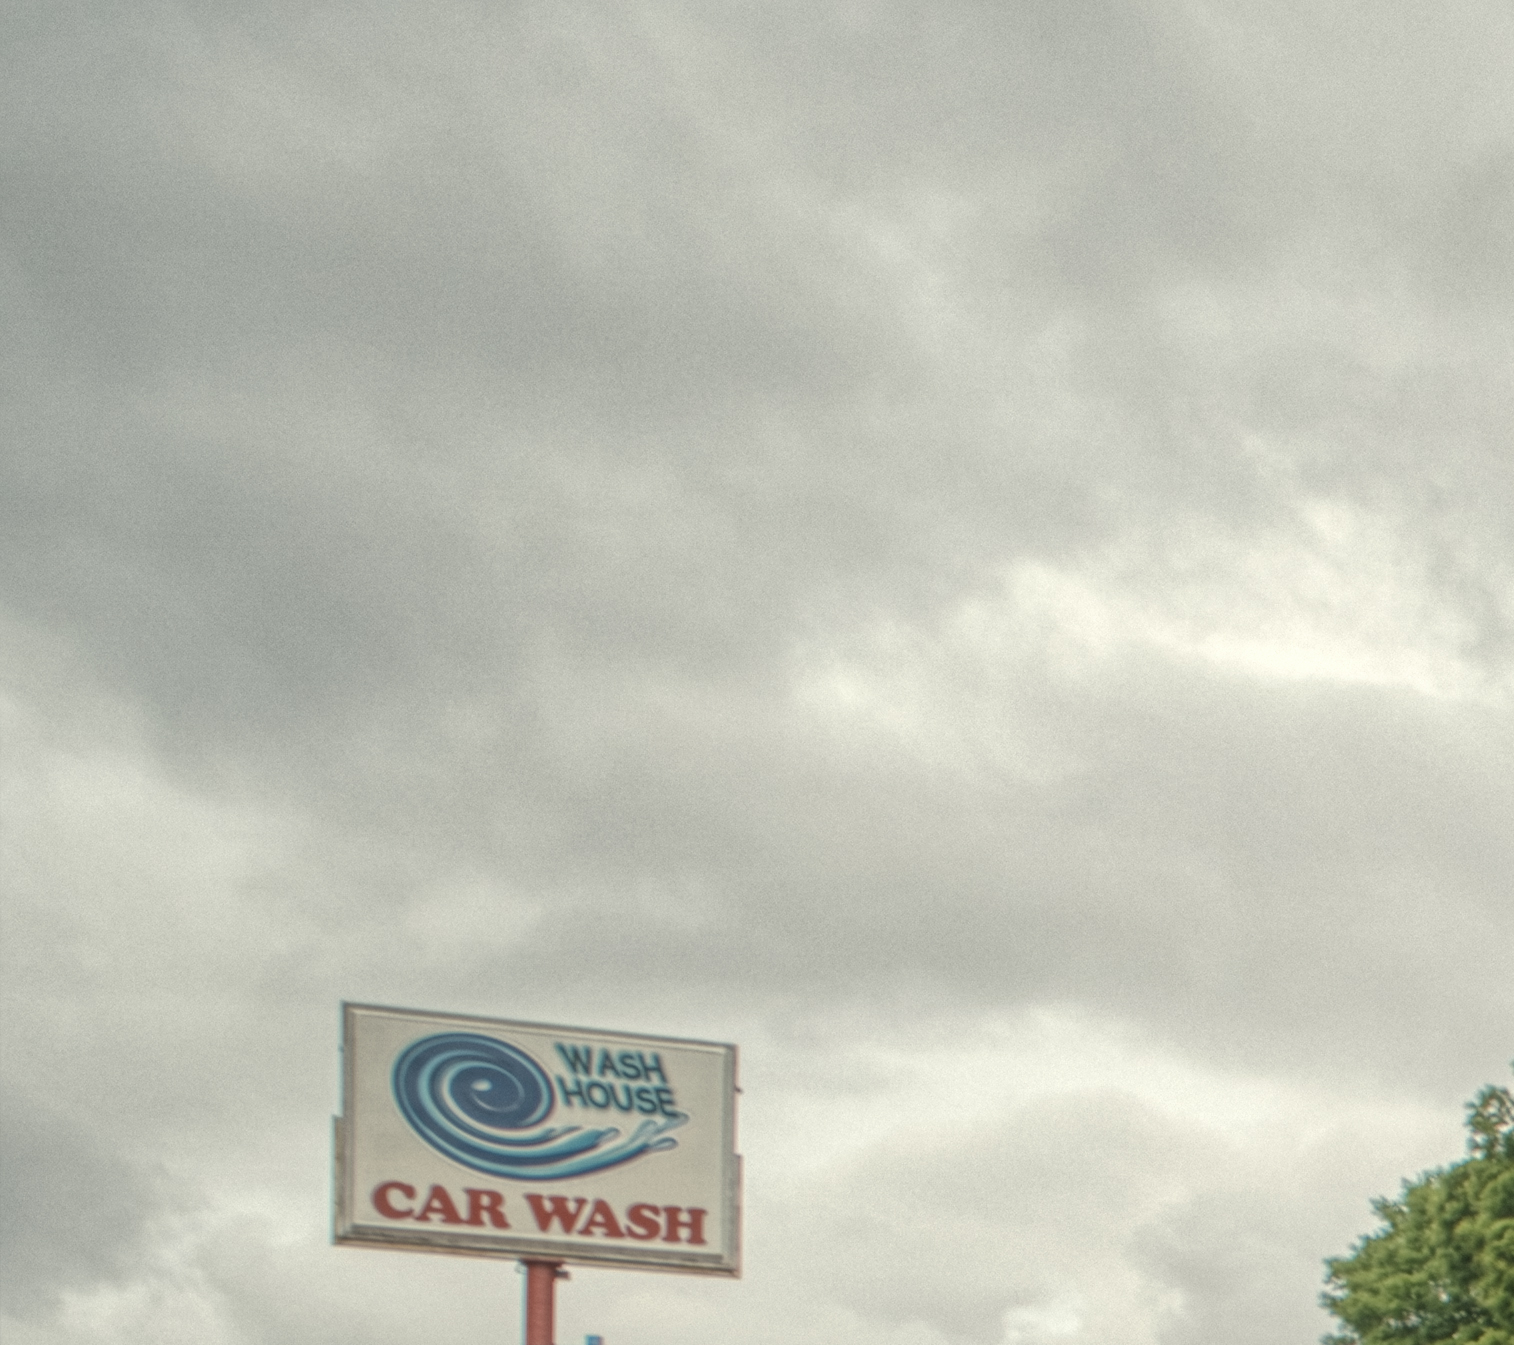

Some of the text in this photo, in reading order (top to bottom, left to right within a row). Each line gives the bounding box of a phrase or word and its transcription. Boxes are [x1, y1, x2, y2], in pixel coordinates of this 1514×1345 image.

[554, 1042, 669, 1085] WASH
[556, 1075, 679, 1119] HOUSE
[372, 1179, 708, 1246] CAR WASH
